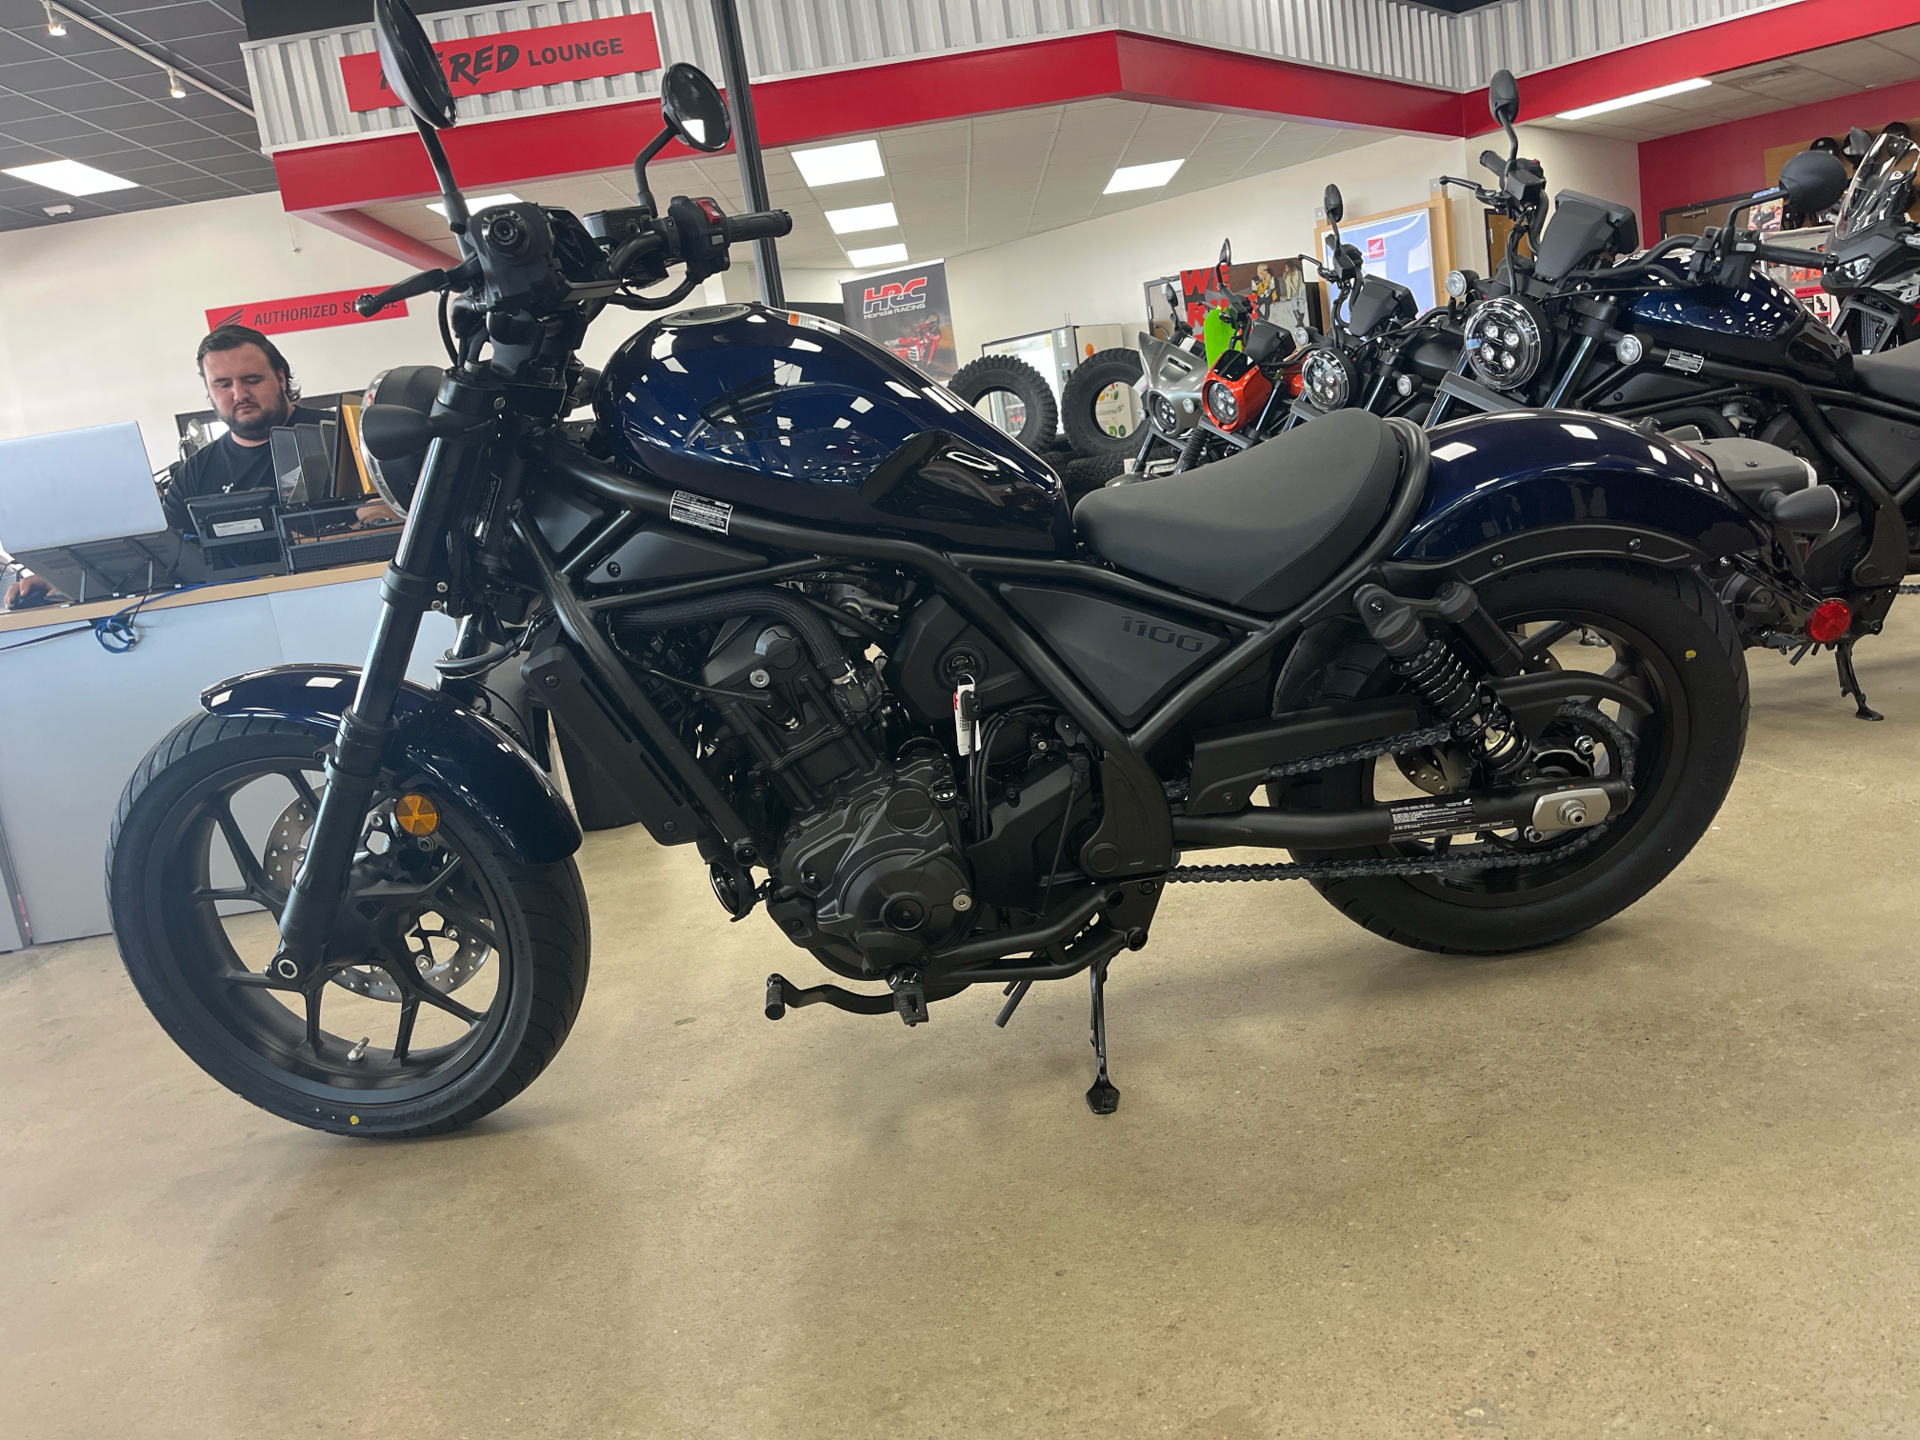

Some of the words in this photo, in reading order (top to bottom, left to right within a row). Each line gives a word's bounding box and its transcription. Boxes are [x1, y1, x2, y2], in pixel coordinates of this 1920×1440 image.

[450, 43, 520, 86] RED
[528, 37, 624, 67] LOUNGE
[254, 303, 338, 326] AUTHORIZED
[863, 276, 928, 315] HRC
[893, 303, 926, 314] RACING
[1121, 615, 1205, 653] 1100
